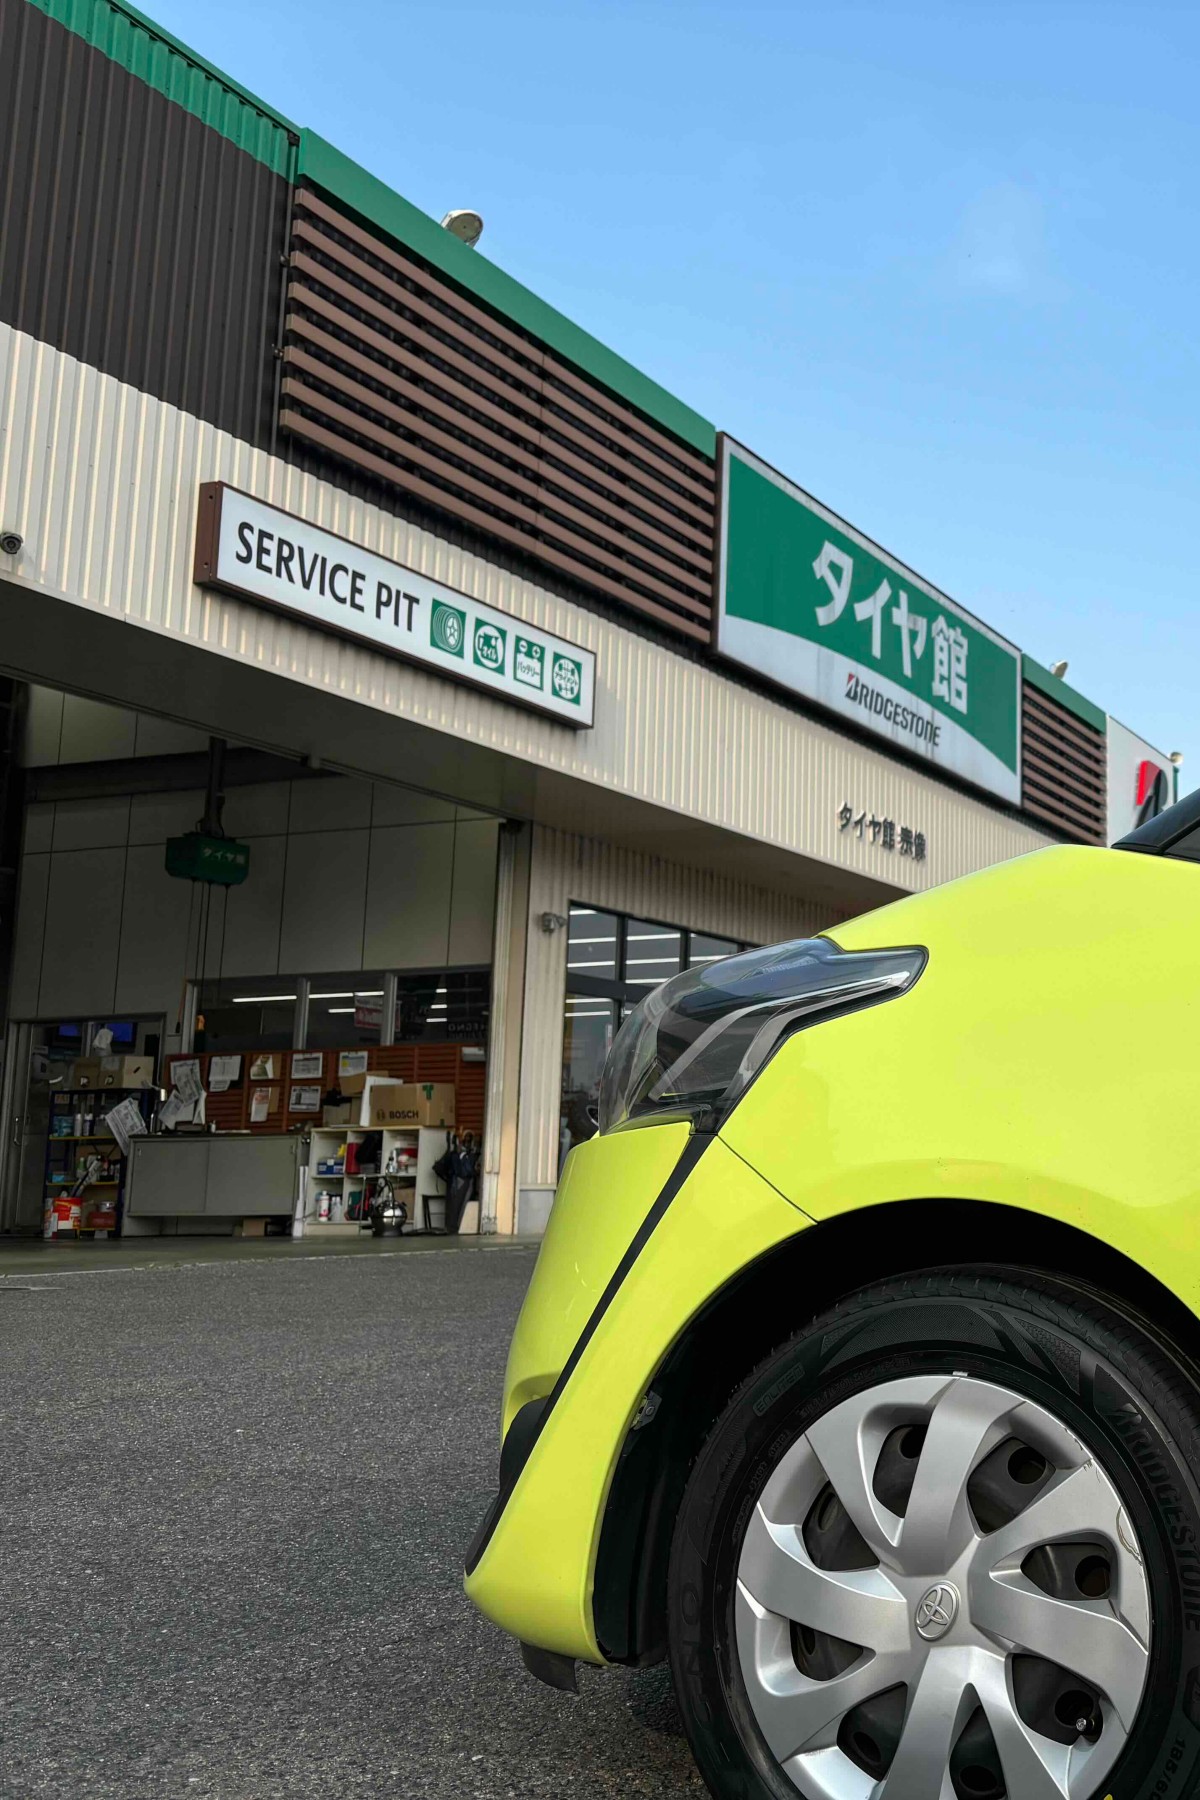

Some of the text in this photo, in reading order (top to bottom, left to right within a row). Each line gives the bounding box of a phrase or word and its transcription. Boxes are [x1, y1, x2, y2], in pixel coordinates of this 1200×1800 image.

[235, 521, 420, 632] SERVICE PIT
[812, 540, 968, 715] タイヤ館
[845, 673, 941, 747] BRIDGESTONE
[838, 800, 896, 851] タイヤ館
[389, 1110, 419, 1119] BOSCH
